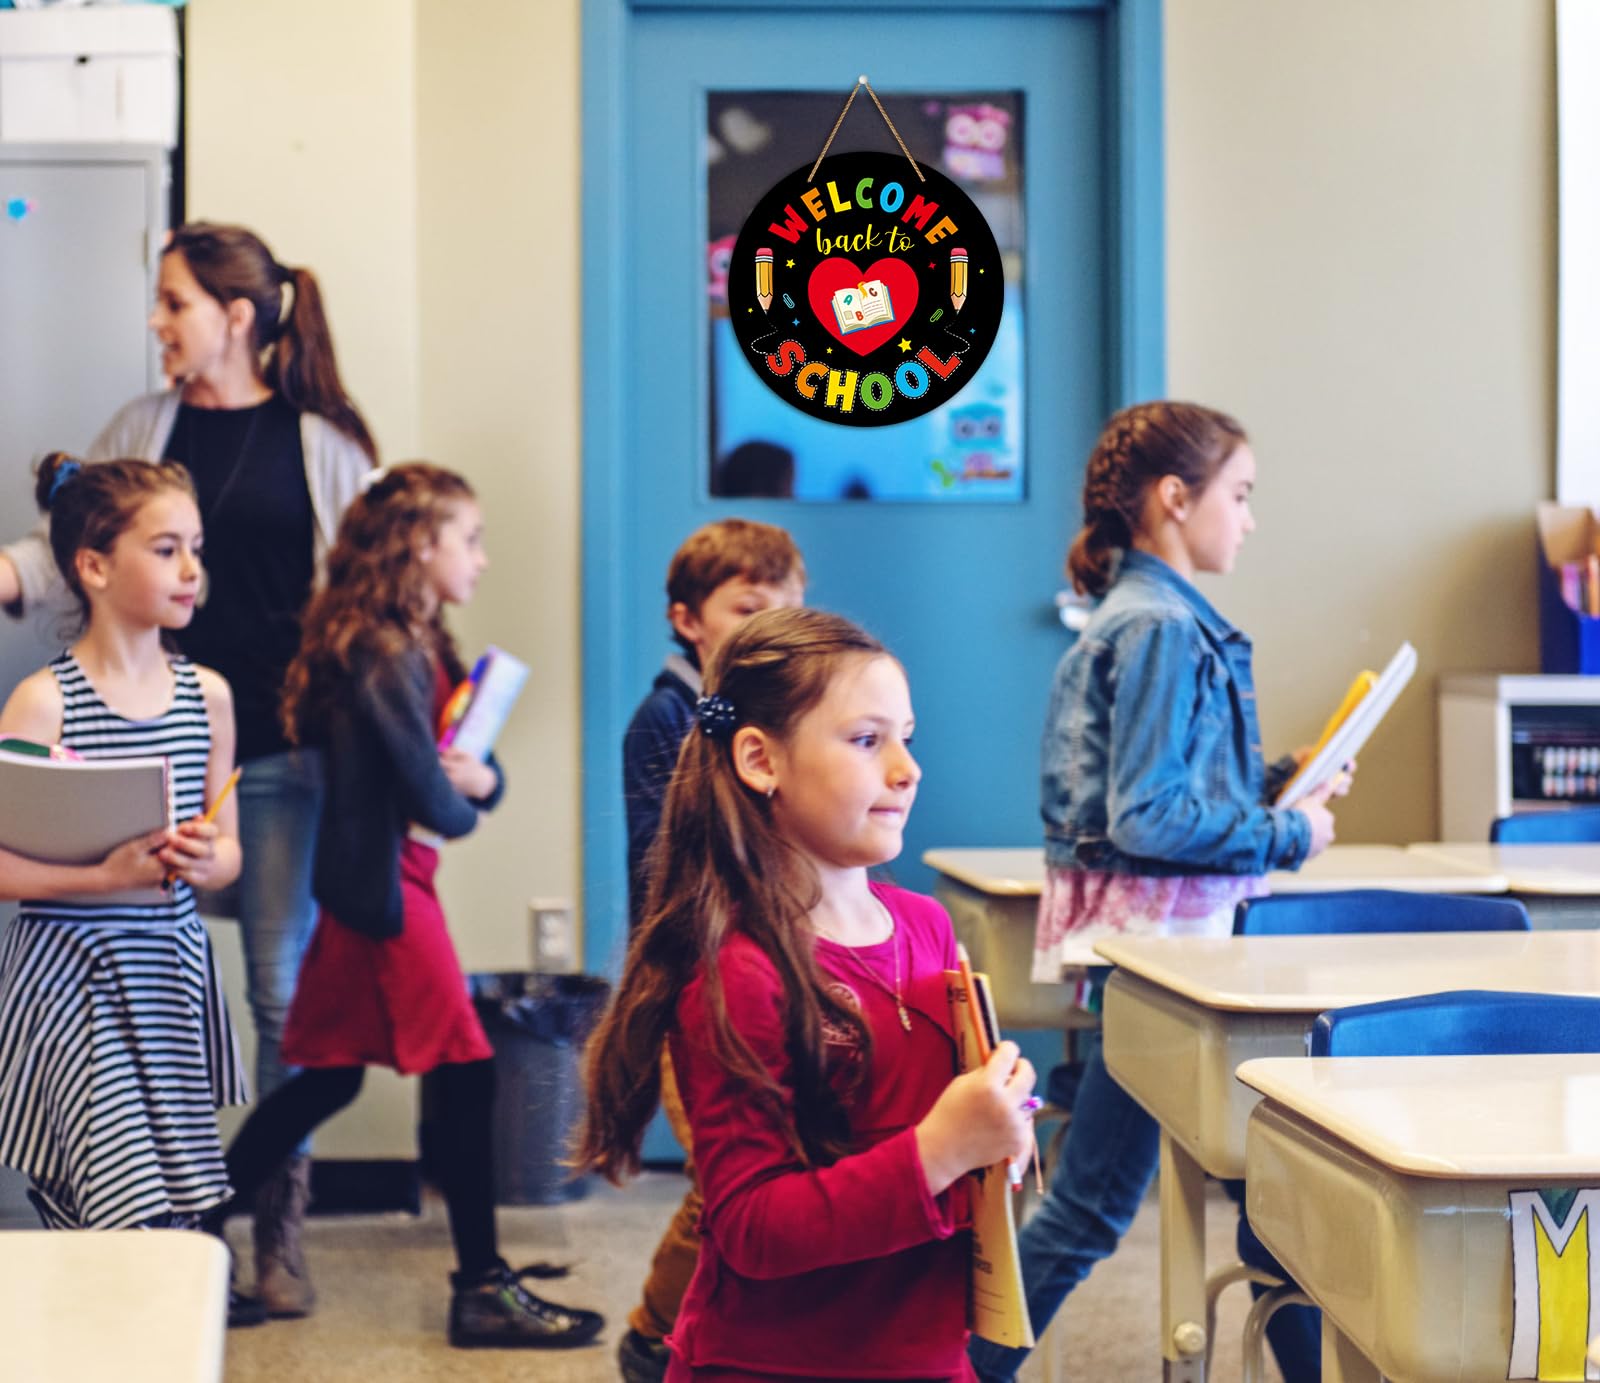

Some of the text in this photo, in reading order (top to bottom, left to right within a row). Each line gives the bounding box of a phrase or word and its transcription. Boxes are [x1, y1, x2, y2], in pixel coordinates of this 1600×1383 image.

[768, 177, 959, 245] WELCOME
[816, 223, 915, 255] back to
[843, 294, 853, 306] A
[868, 287, 878, 297] C
[855, 310, 864, 321] B
[766, 339, 962, 413] SCHOOL
